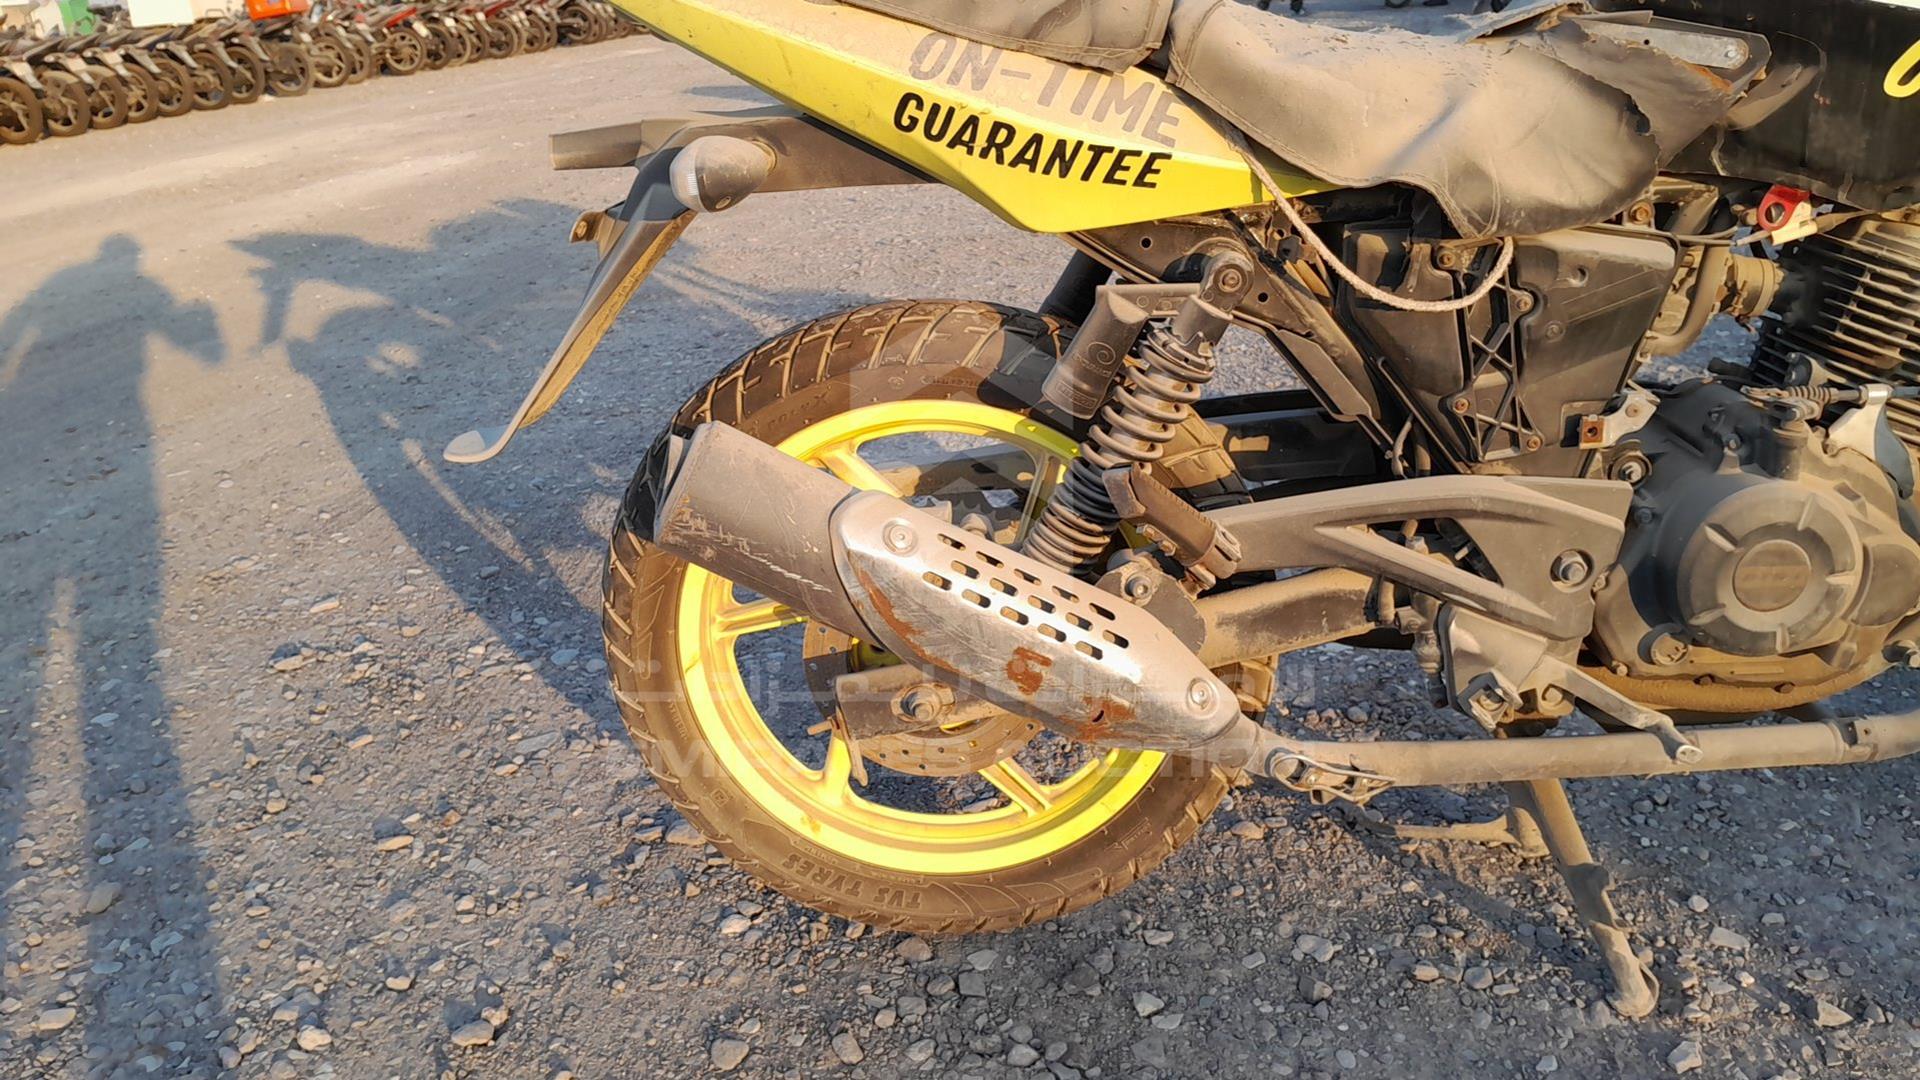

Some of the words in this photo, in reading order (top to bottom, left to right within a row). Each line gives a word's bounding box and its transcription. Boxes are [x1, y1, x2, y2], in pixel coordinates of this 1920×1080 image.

[908, 31, 1181, 148] ON-TIME
[893, 92, 1172, 189] GUARANTEE
[781, 852, 865, 898] TYRES
[874, 885, 922, 909] TVS
